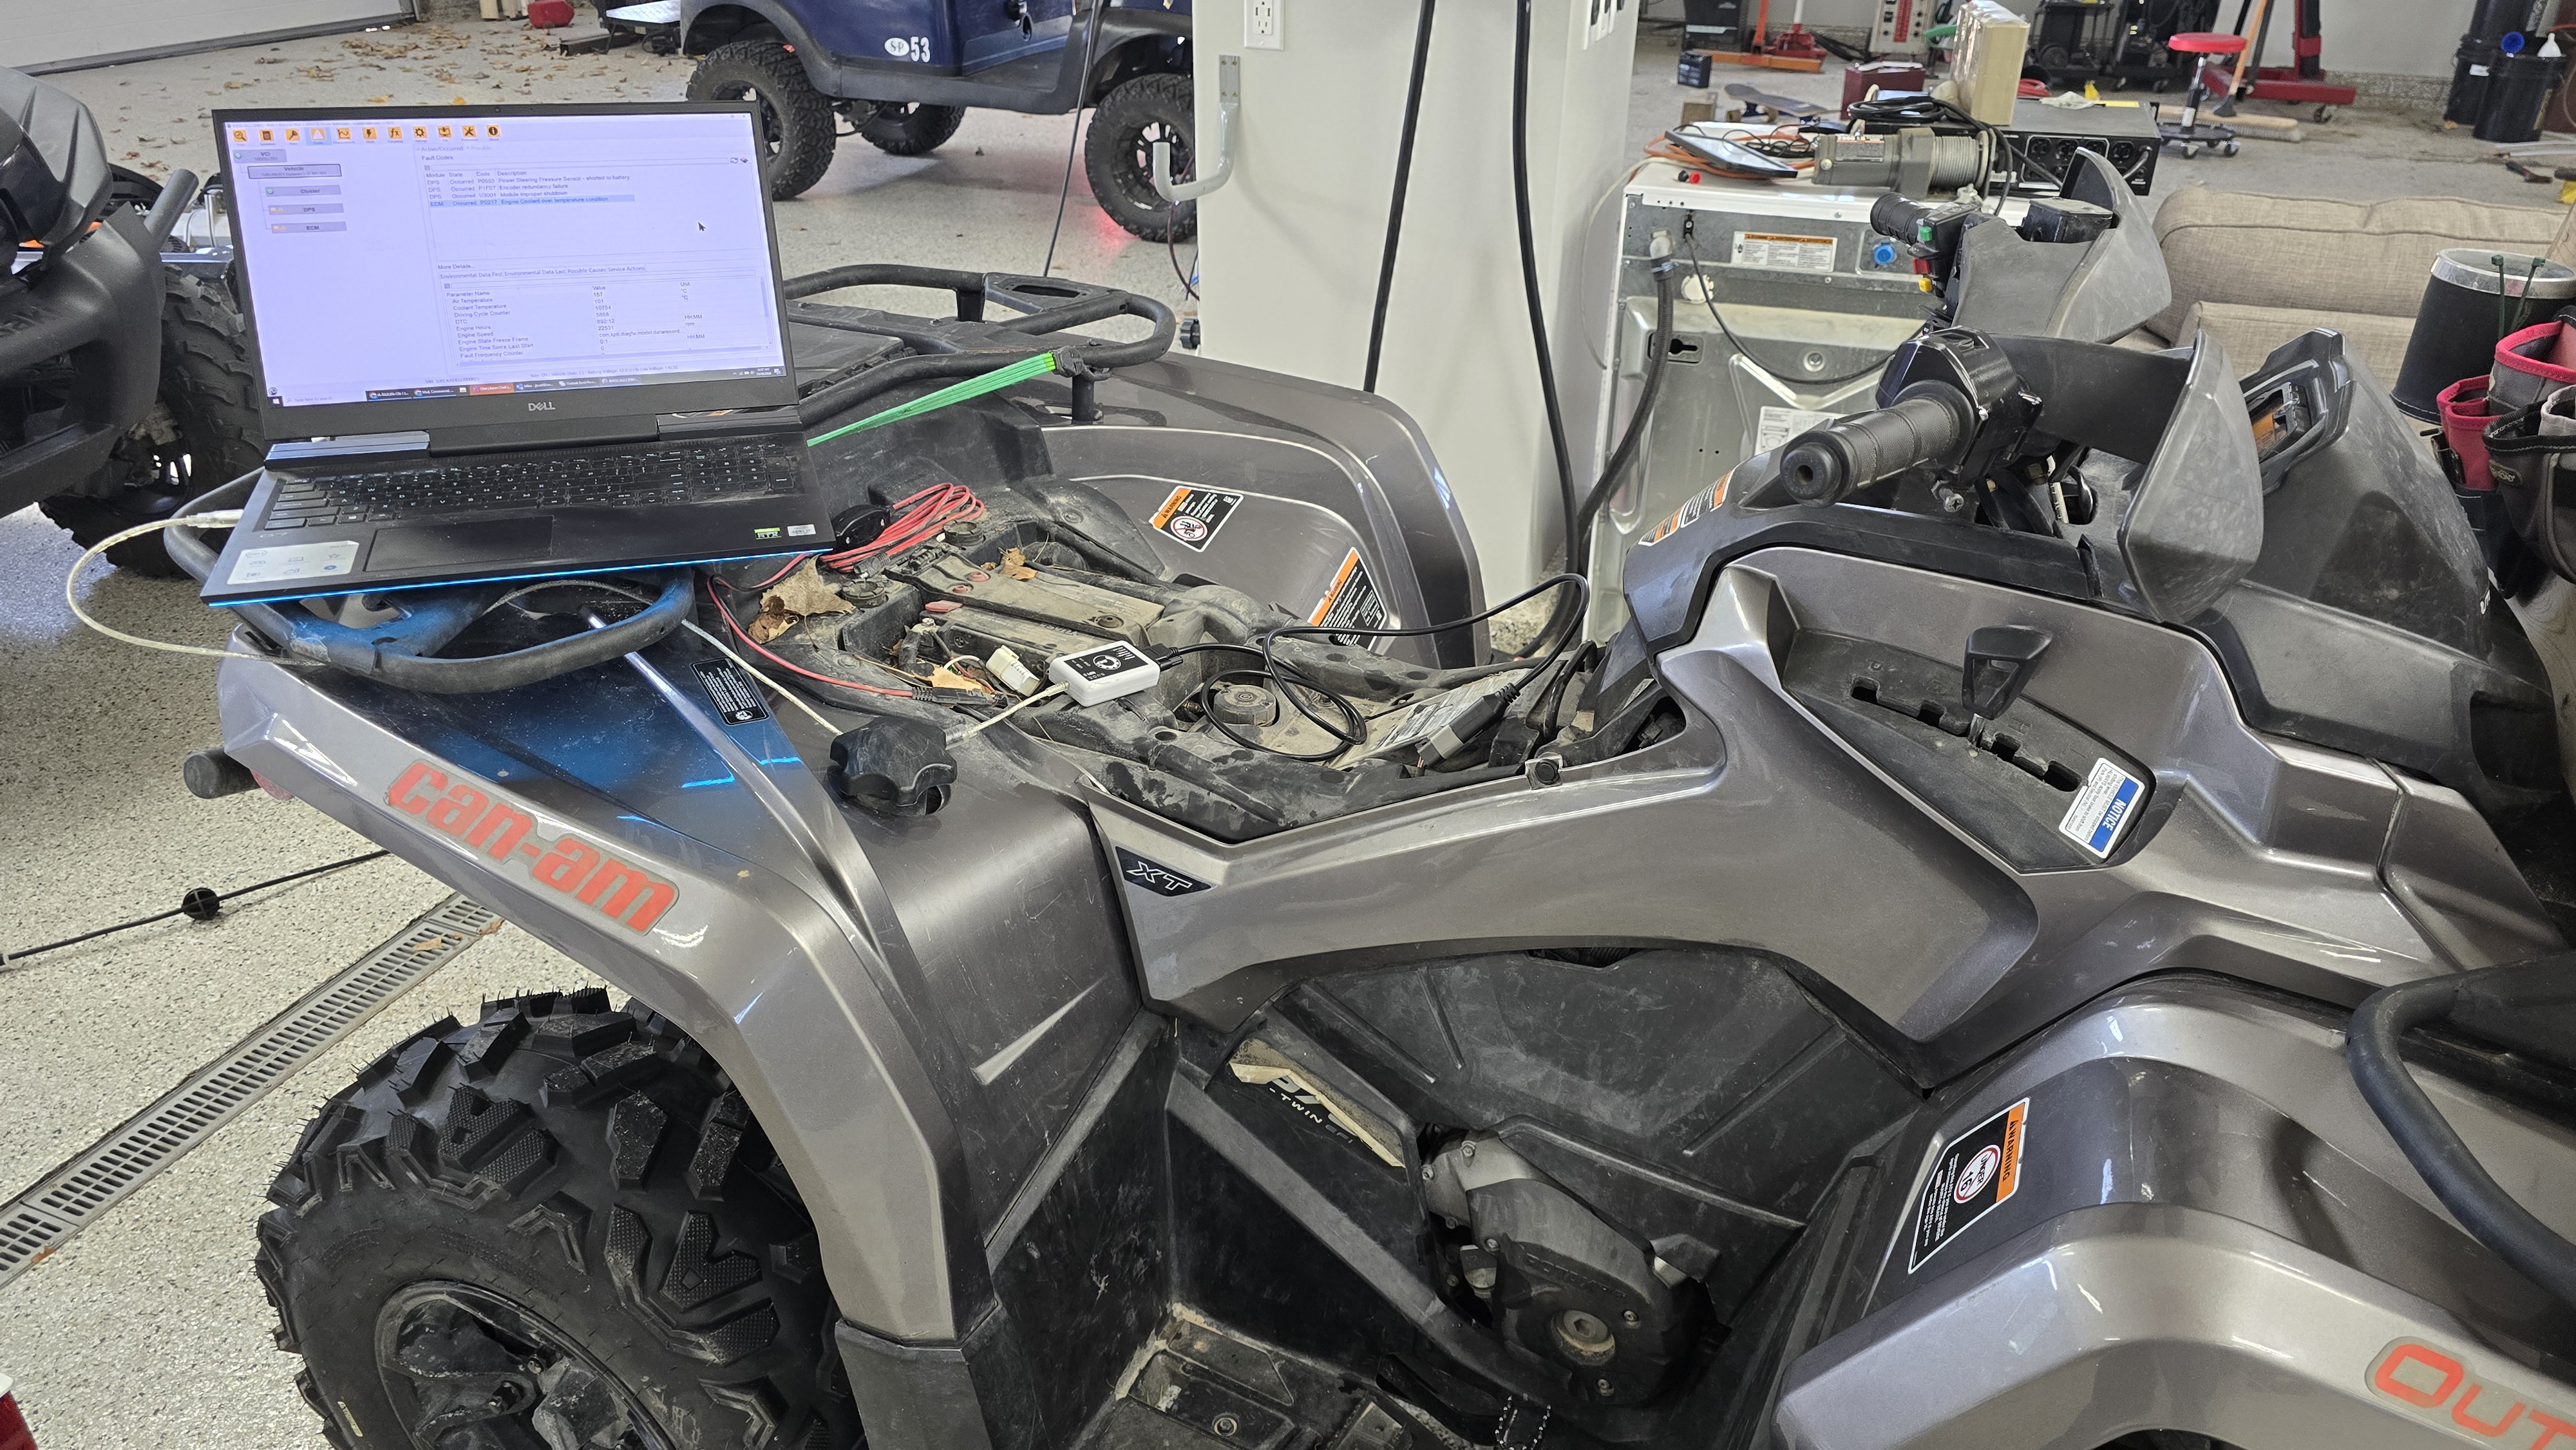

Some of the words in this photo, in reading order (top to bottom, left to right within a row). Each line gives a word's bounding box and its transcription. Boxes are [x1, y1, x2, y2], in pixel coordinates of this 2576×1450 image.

[910, 36, 931, 62] 53
[528, 401, 556, 411] DELL
[1164, 494, 1182, 514] WARNING
[2099, 766, 2108, 777] Park
[2107, 773, 2118, 787] shifting
[2085, 787, 2096, 802] Neutral
[2094, 784, 2105, 796] apply
[2106, 783, 2119, 801] VEHICLE
[2086, 801, 2095, 813] brake
[2099, 799, 2110, 812] MUST
[2079, 814, 2087, 824] shift
[2088, 814, 2101, 831] stopped
[2101, 798, 2127, 831] NOTICE
[2074, 822, 2083, 833] from
[2083, 829, 2094, 842] before
[388, 762, 676, 932] can-am
[1126, 861, 1193, 890] XT
[1325, 1124, 1353, 1144] EFI
[2002, 1130, 2014, 1182] WARNING
[1978, 1154, 1988, 1187] UNDER
[1962, 1171, 1975, 1191] 16
